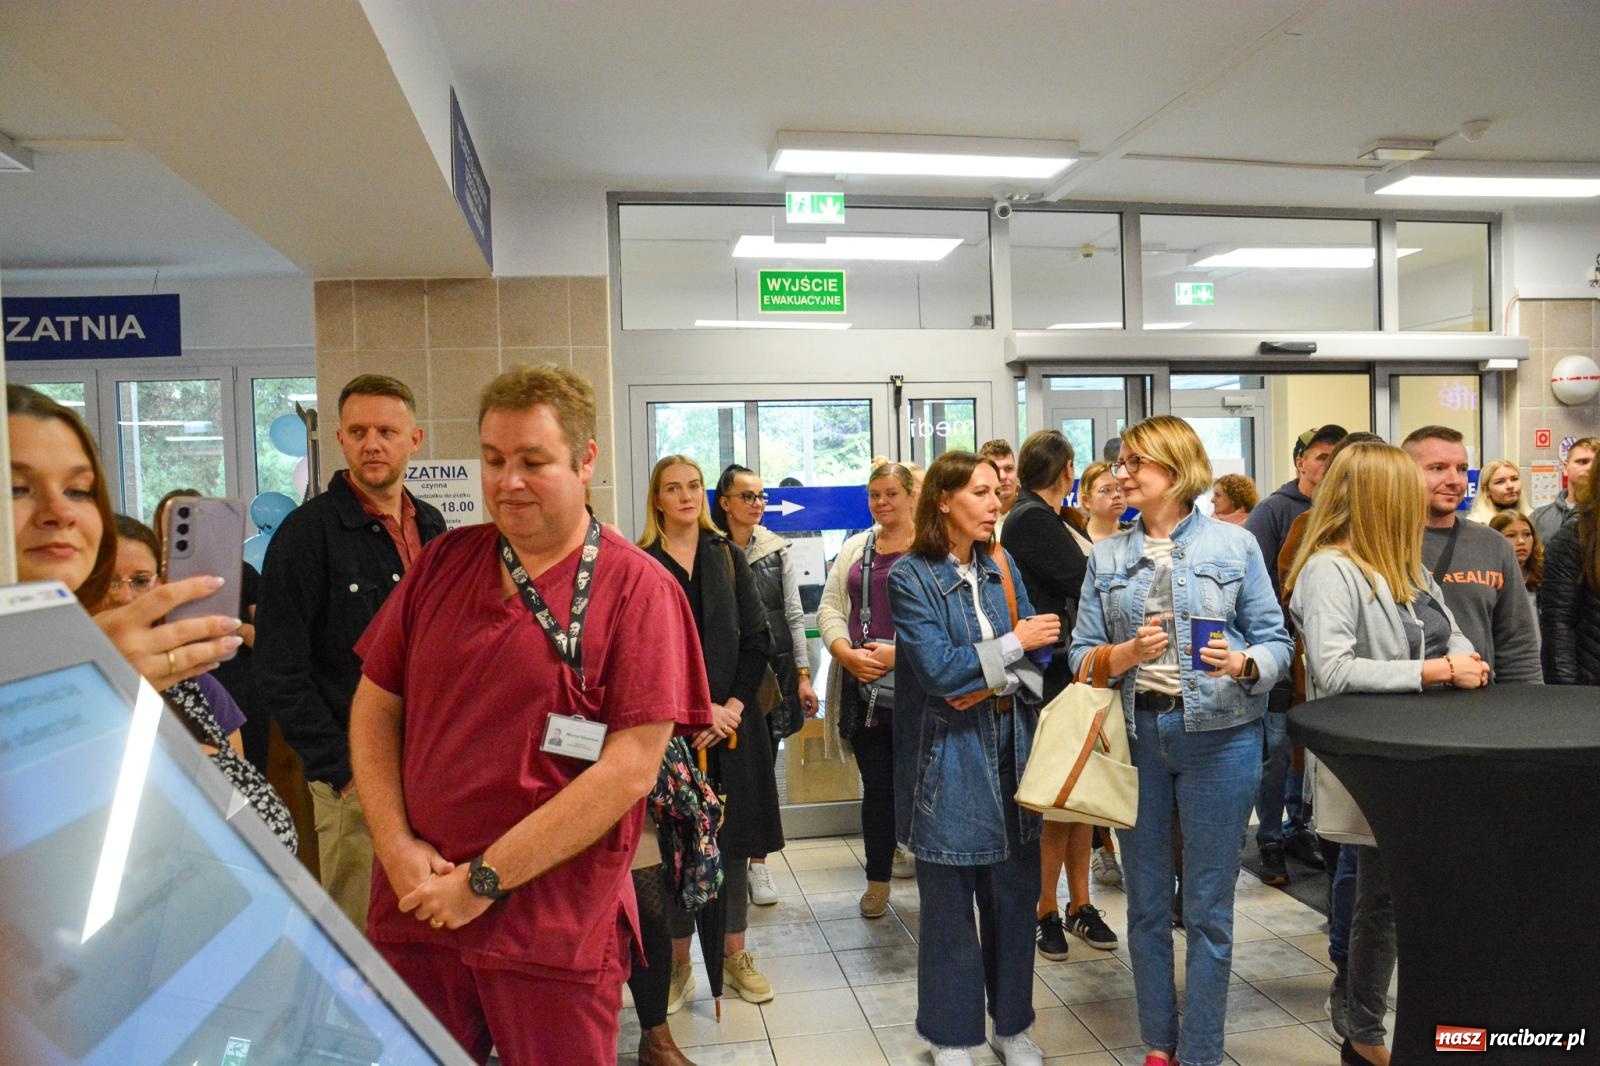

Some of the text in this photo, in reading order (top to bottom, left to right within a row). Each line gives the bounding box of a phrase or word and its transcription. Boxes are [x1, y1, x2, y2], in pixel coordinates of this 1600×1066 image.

[766, 274, 839, 292] WYJŚCIE
[763, 295, 841, 305] EWAKUACYJNE
[5, 314, 147, 342] ZATNIA
[441, 501, 474, 512] 18.00
